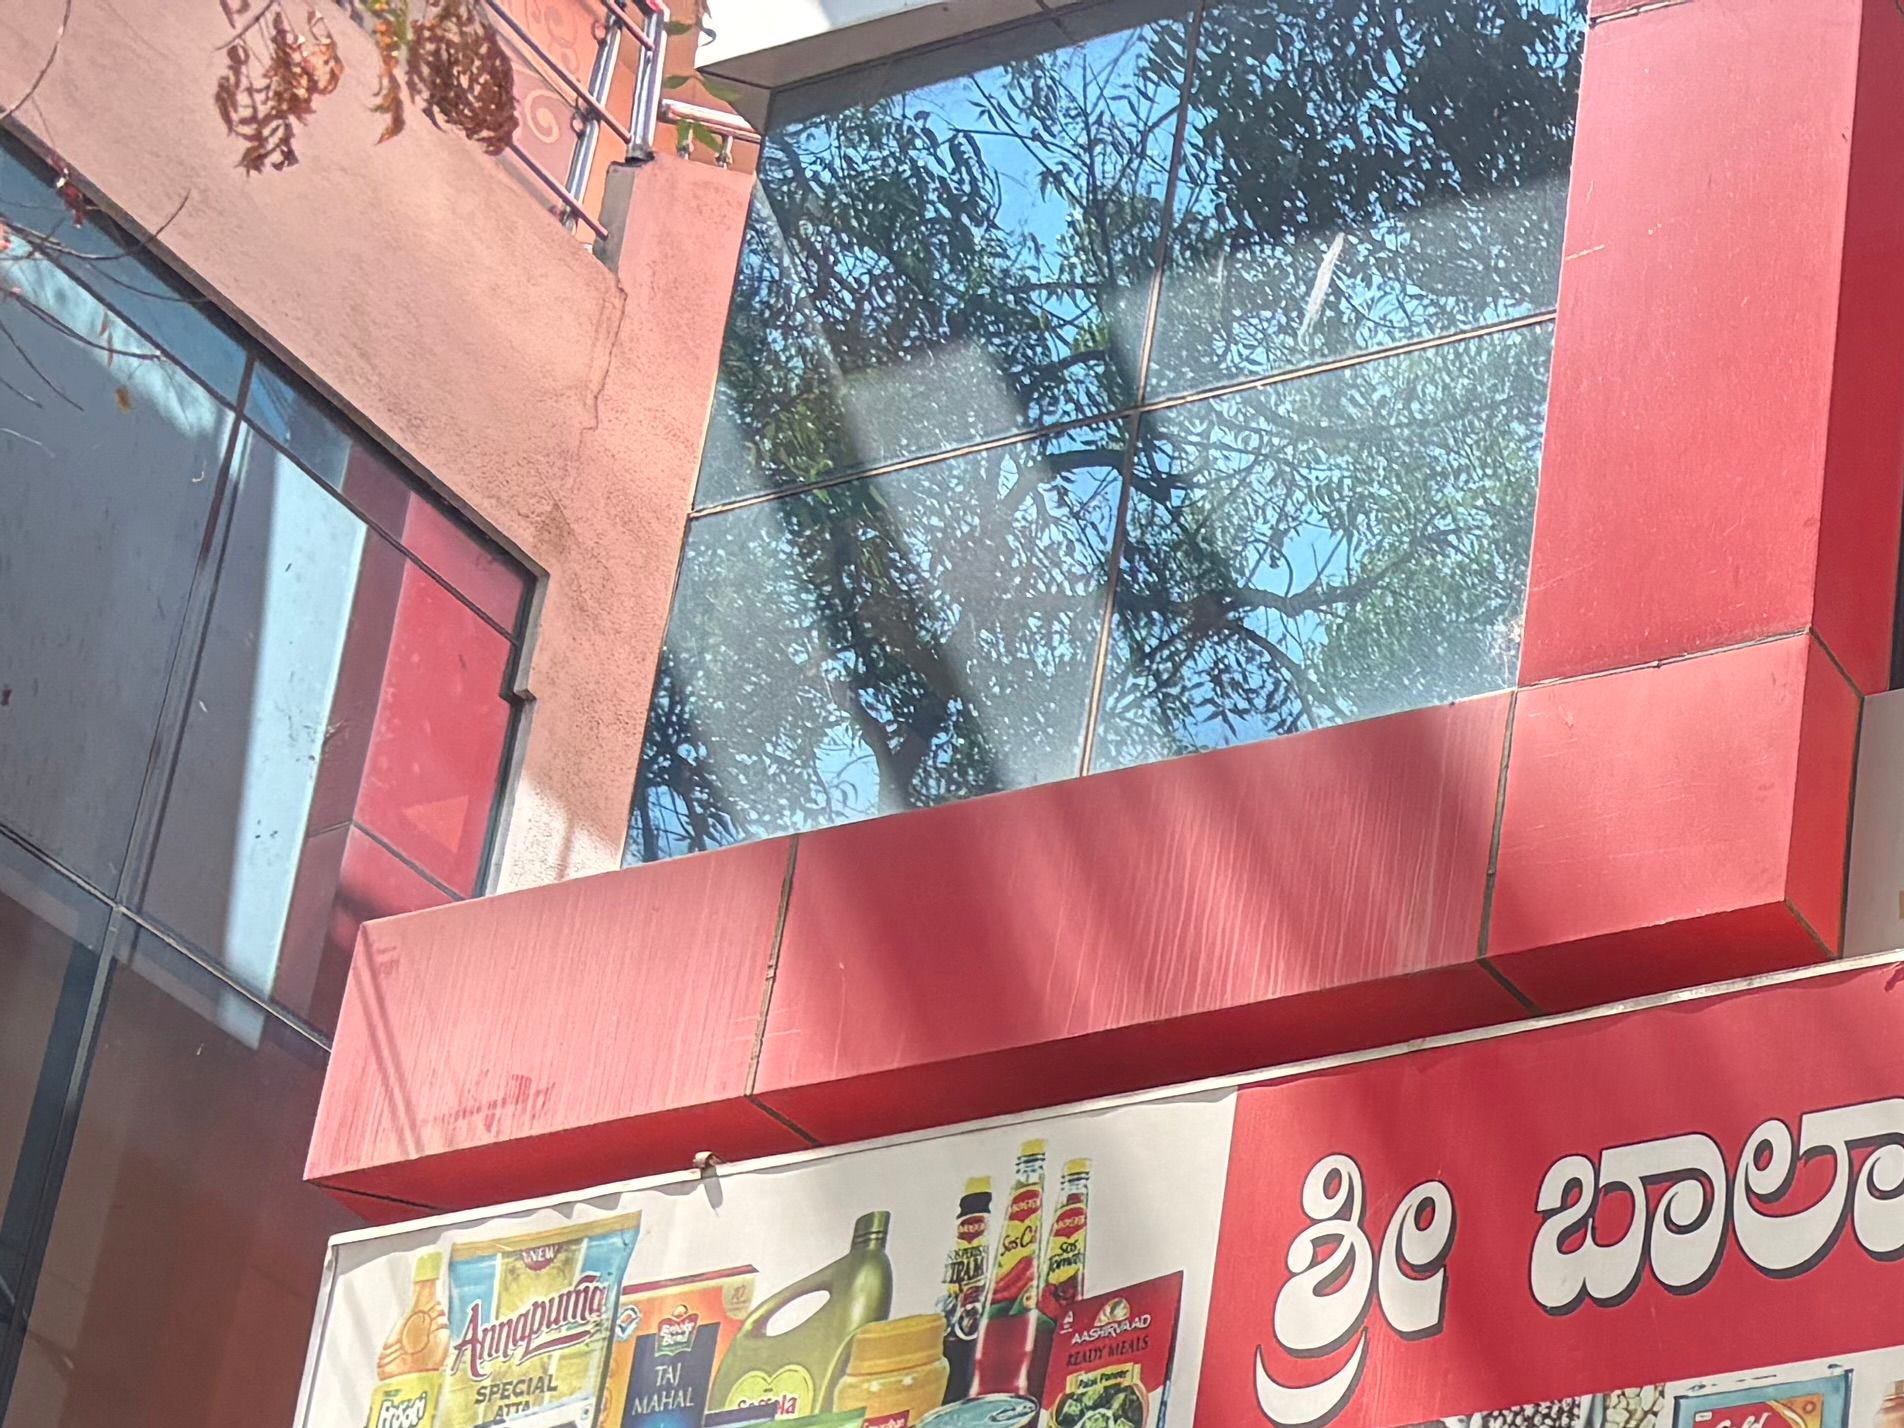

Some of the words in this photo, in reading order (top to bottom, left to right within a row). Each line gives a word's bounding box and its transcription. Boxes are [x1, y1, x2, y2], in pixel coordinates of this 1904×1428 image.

[451, 1274, 606, 1381] Annapurna
[1072, 1313, 1151, 1345] AASHIRVAAD
[1066, 1343, 1104, 1367] READY
[1108, 1336, 1149, 1358] MEALS
[655, 1362, 682, 1387] TAJ
[474, 1375, 558, 1405] SPECIAL
[632, 1393, 694, 1416] MAHAL
